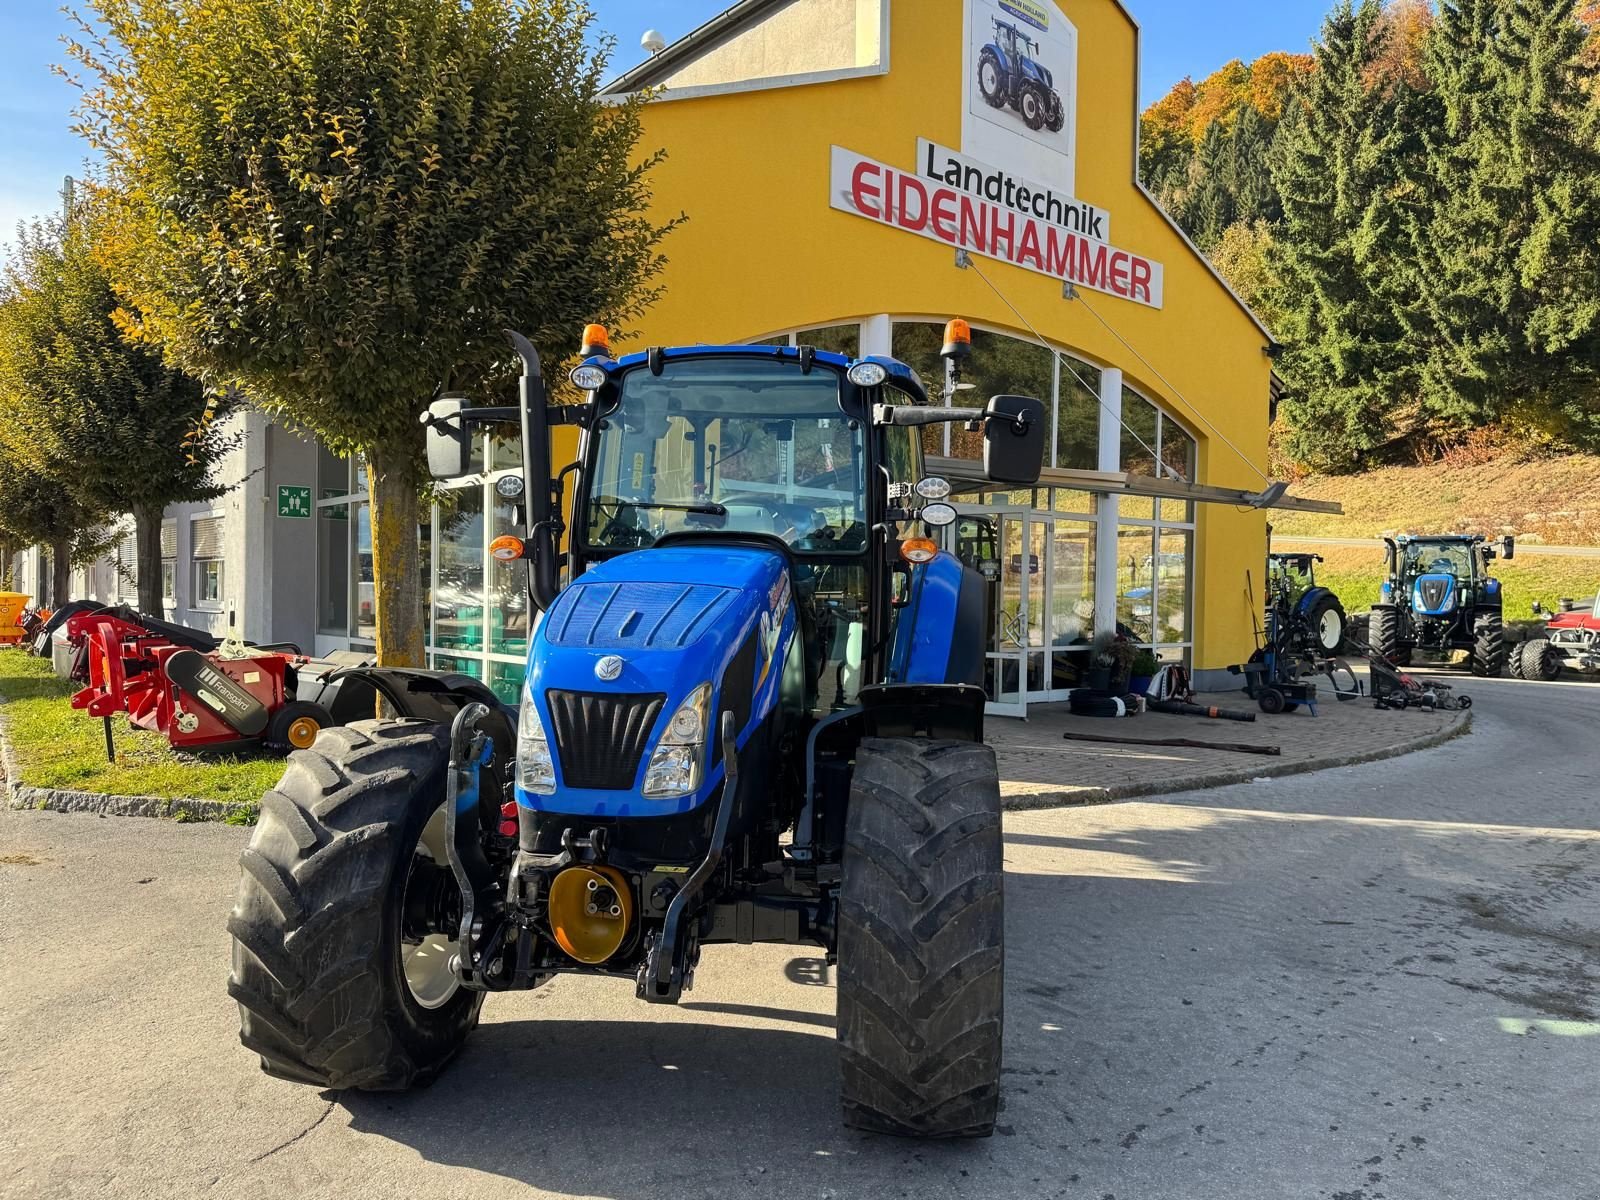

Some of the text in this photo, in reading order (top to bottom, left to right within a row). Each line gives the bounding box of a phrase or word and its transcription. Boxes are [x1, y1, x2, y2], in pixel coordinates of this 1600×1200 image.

[852, 161, 1151, 303] EIDENHAMMER
[927, 143, 1102, 239] Landtechnik
[214, 681, 250, 710] Fransgård
